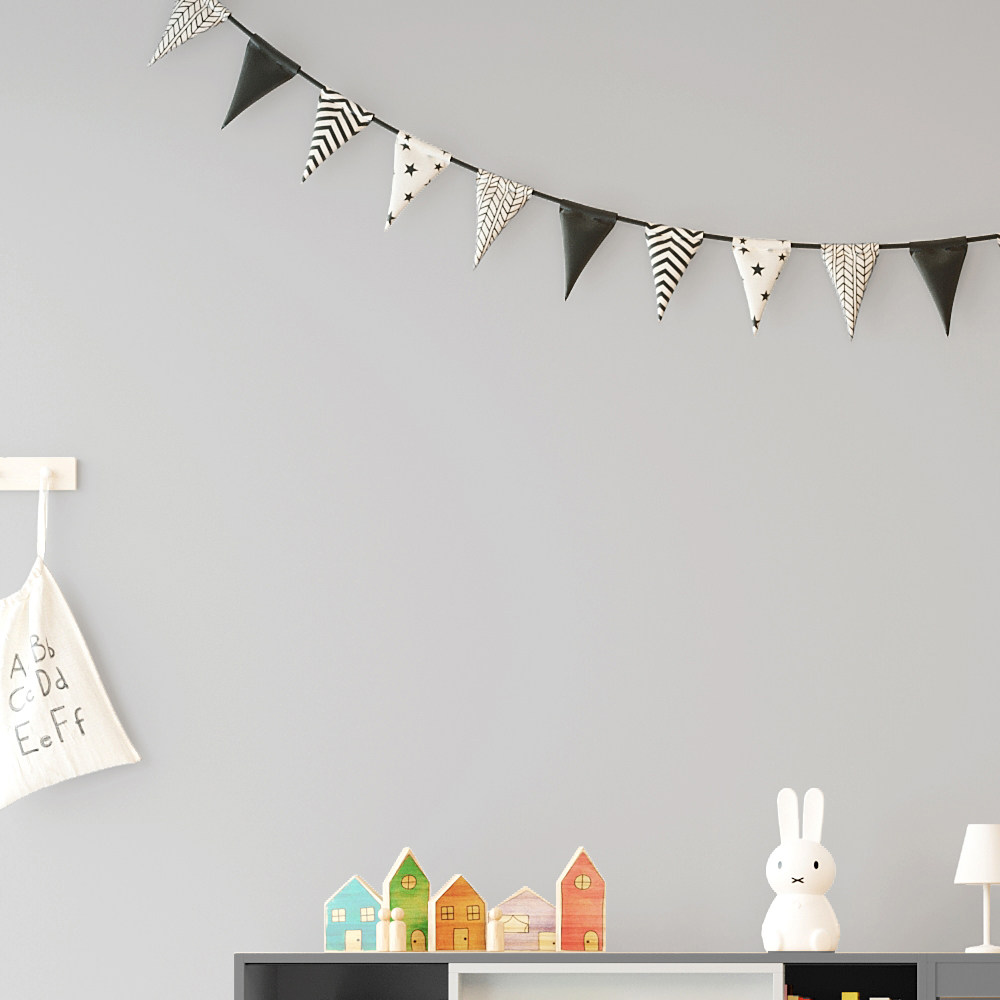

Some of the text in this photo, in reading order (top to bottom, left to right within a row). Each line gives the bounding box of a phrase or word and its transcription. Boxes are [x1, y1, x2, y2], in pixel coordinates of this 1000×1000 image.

[30, 634, 56, 663] Bb
[8, 666, 69, 712] Cc Dd
[14, 705, 86, 756] Ee Ff
